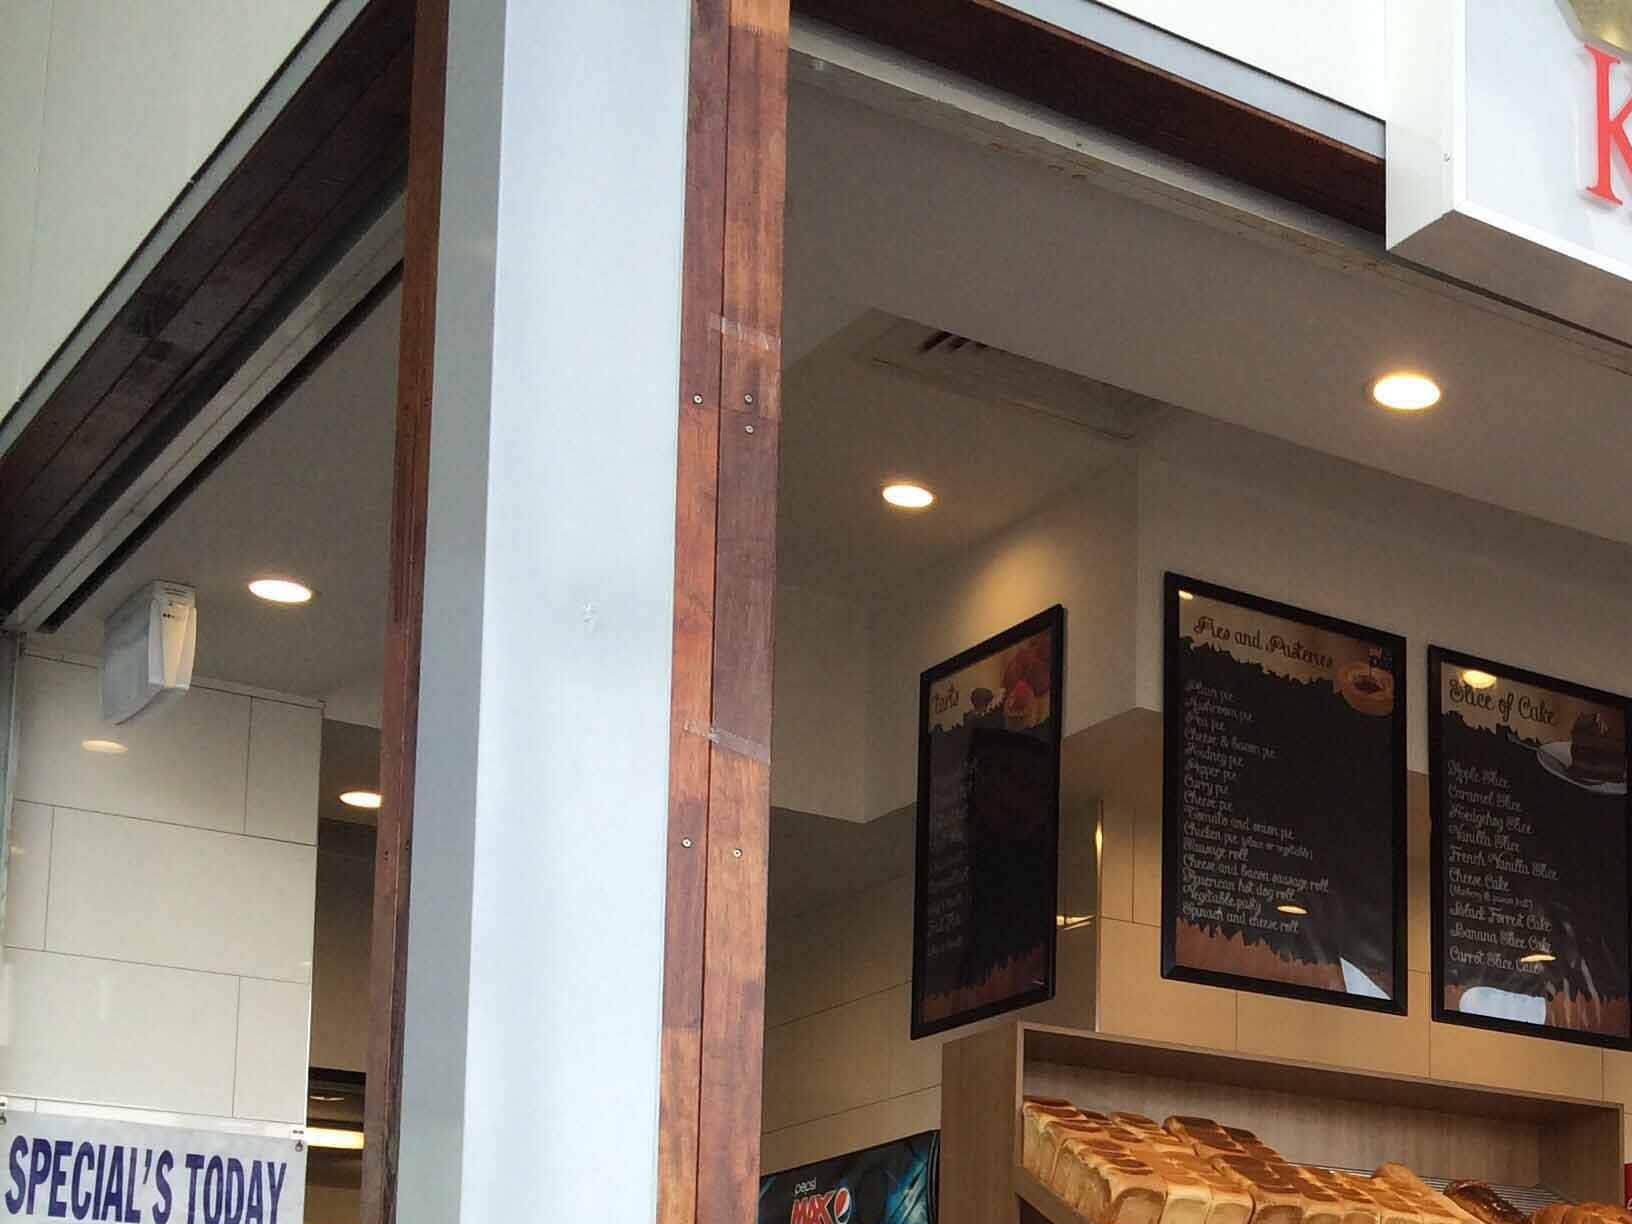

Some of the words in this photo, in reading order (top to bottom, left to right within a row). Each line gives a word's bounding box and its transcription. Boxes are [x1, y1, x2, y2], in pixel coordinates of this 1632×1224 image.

[1233, 622, 1262, 650] and
[1448, 677, 1493, 711] Slice
[1497, 689, 1514, 724] of
[1518, 694, 1556, 727] Cake
[1228, 845, 1248, 862] roll
[1310, 874, 1328, 893] roll
[1484, 871, 1511, 892] Cake
[1275, 885, 1296, 901] roll
[1526, 913, 1553, 934] Cake
